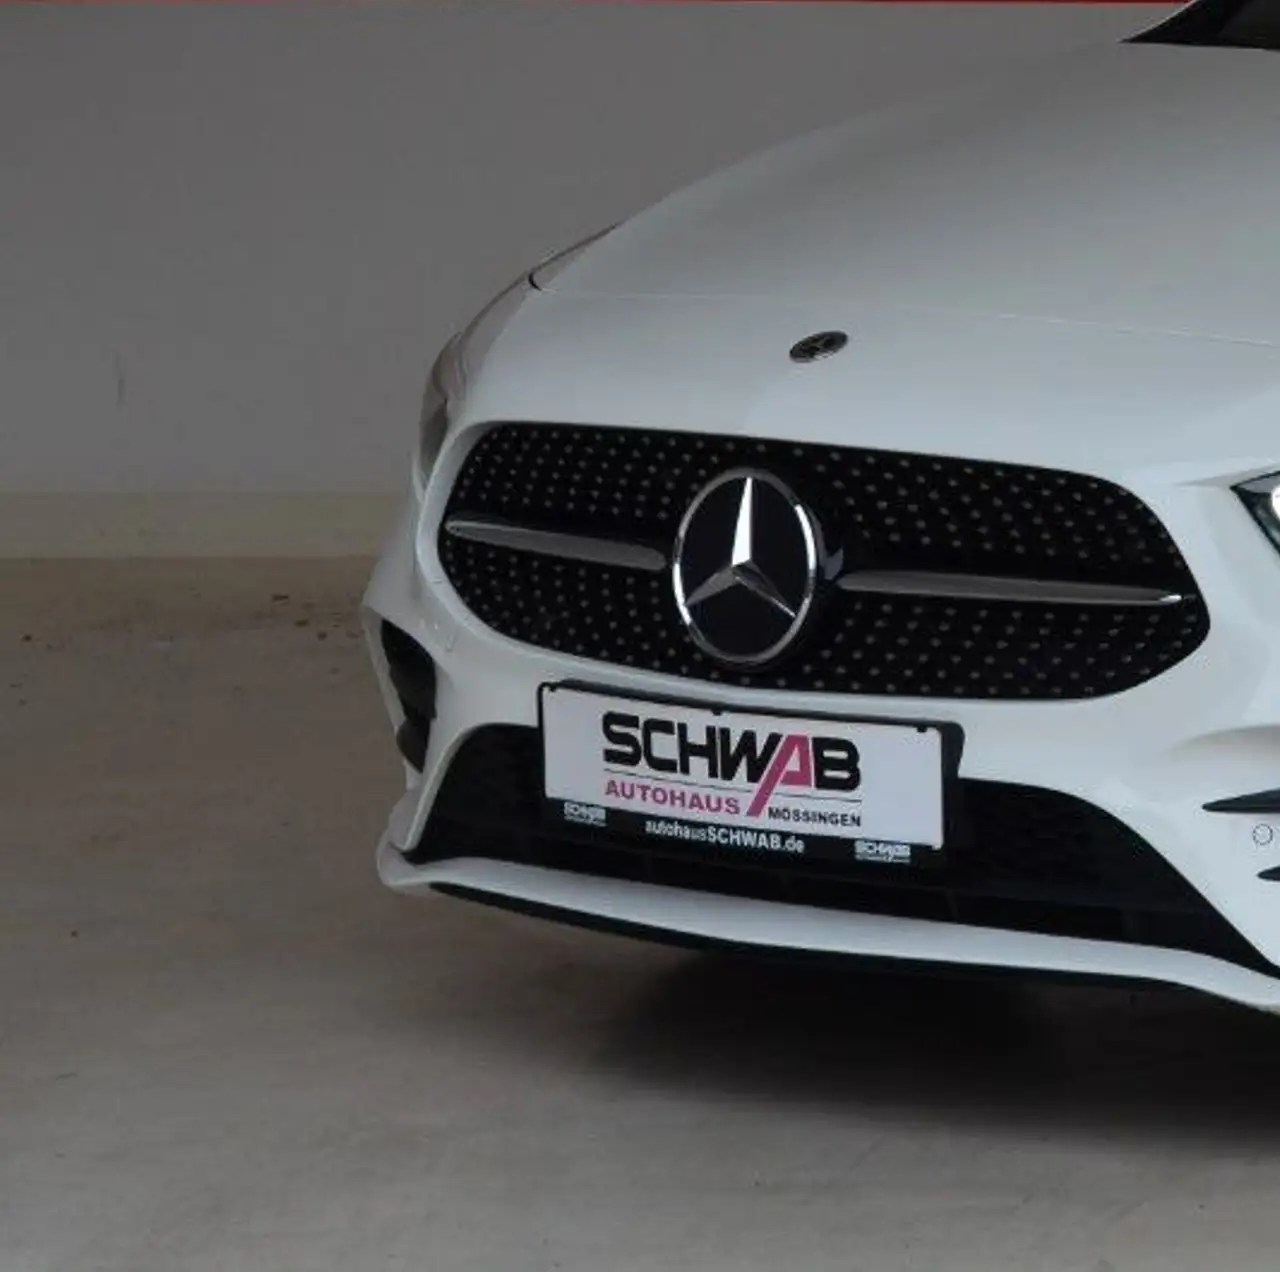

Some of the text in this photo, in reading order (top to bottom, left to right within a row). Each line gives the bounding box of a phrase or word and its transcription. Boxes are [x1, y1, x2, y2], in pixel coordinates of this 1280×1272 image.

[602, 711, 861, 817] SCHWAB
[605, 779, 741, 816] AUTOHAUS
[645, 820, 805, 854] autohausSCHWAB.de
